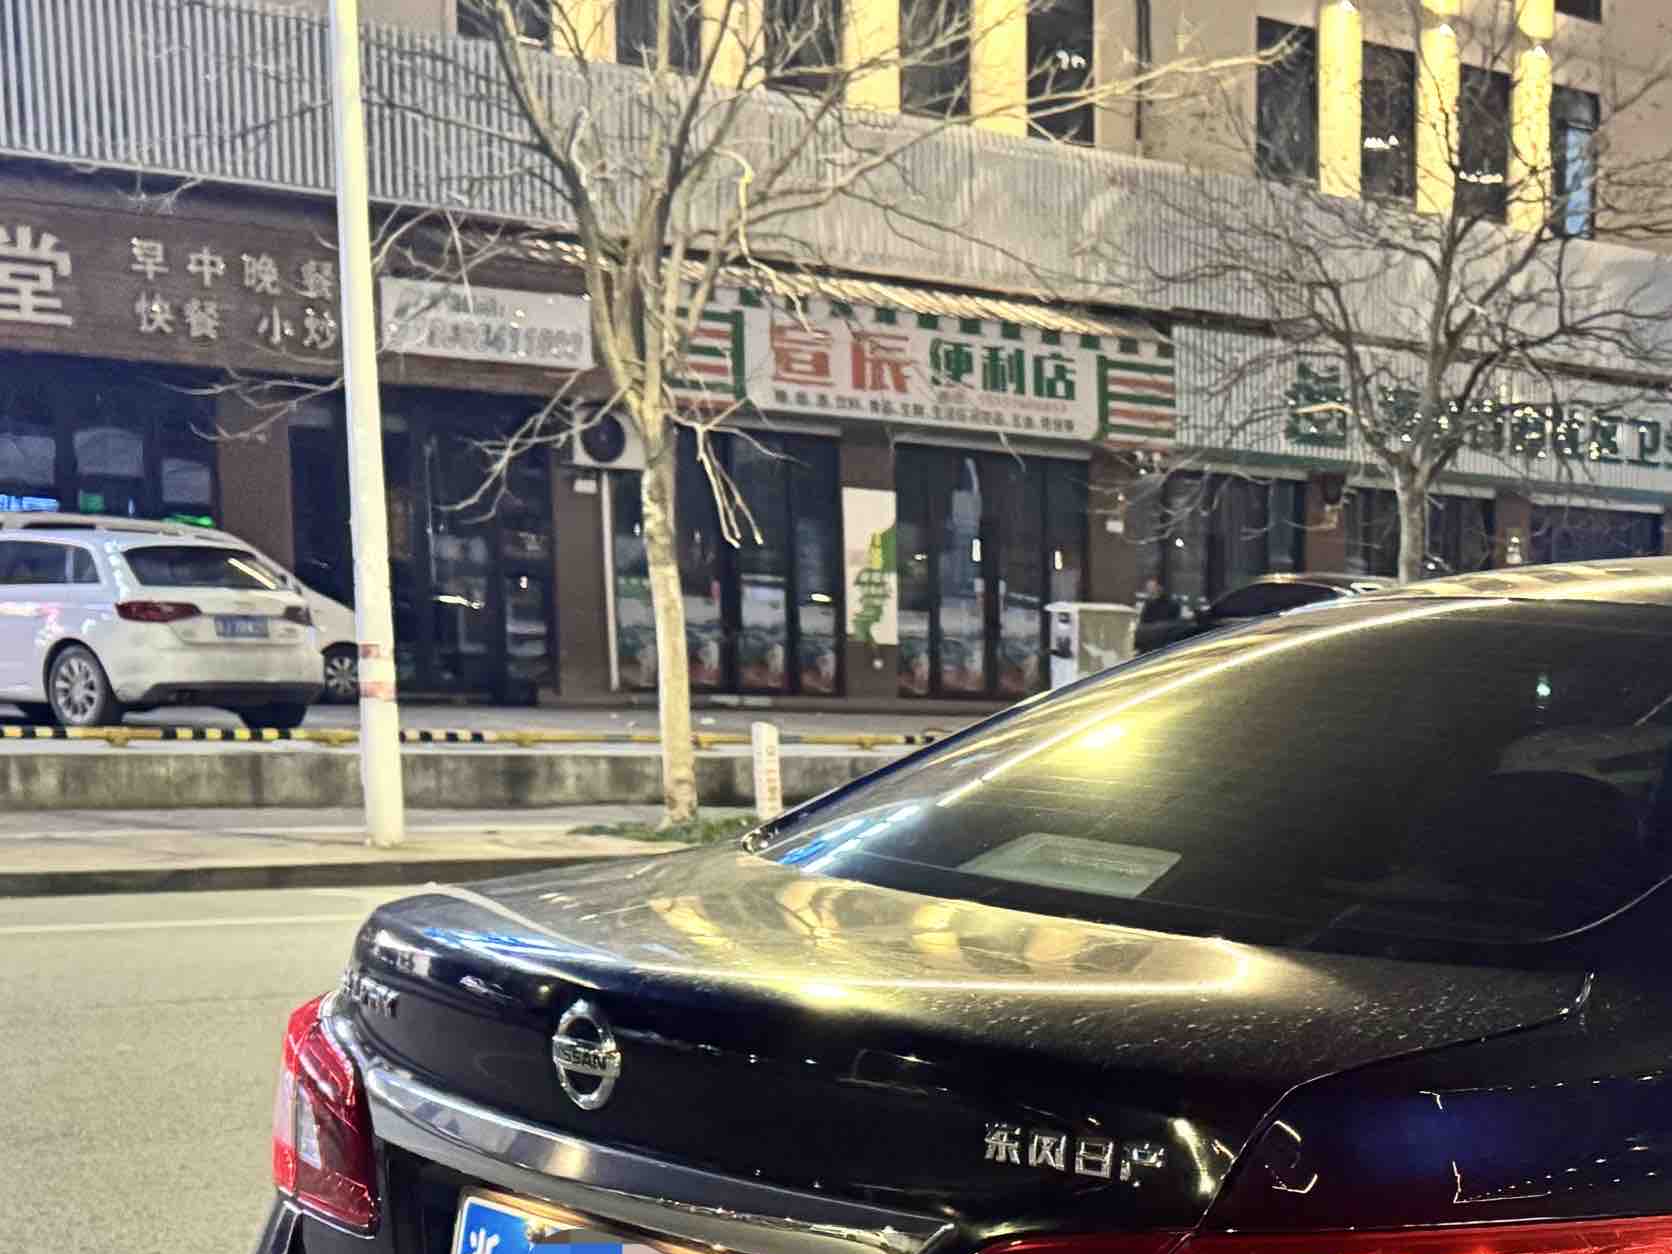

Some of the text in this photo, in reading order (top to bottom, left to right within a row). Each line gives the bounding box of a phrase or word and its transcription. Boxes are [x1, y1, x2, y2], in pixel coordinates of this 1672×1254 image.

[131, 237, 335, 300] 早中晚餐
[135, 291, 336, 350] 快餐 小炒
